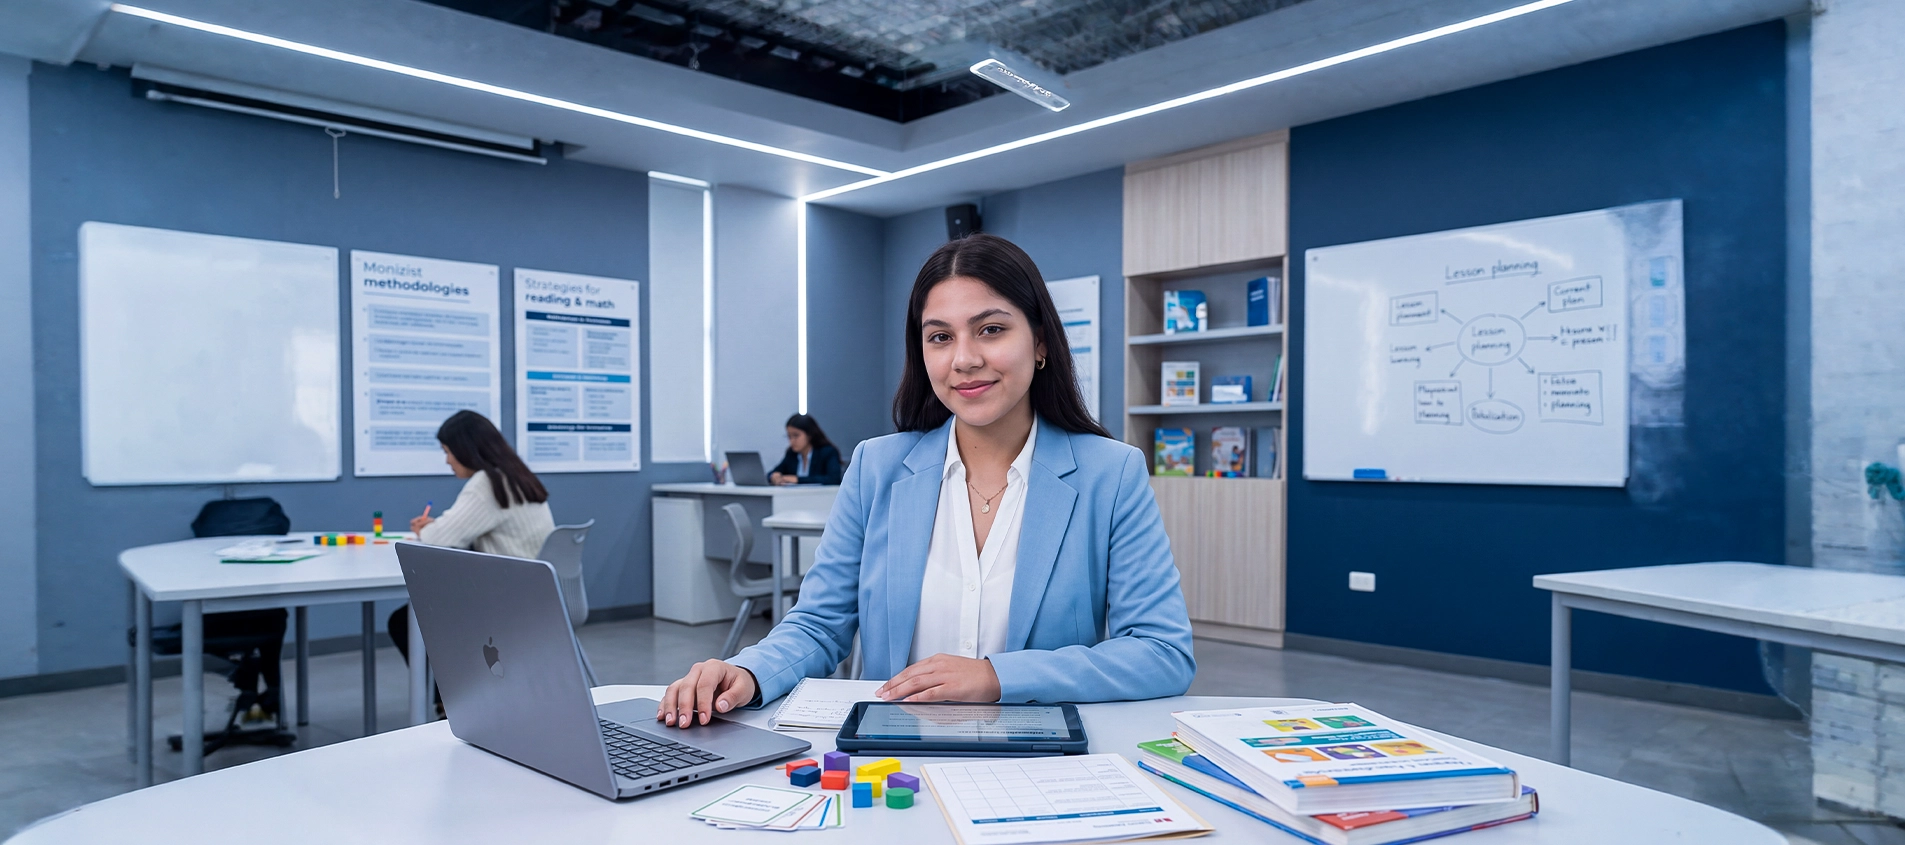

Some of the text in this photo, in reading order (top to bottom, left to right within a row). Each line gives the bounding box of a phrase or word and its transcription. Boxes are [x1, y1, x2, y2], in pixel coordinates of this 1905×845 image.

[363, 261, 423, 278] Monizist
[1445, 259, 1539, 280] Lesson planning
[363, 278, 470, 297] methodologies
[525, 278, 601, 295] Strategies for
[525, 293, 615, 309] reading & math
[1472, 326, 1506, 338] Lesson
[1471, 340, 1511, 357] planning
